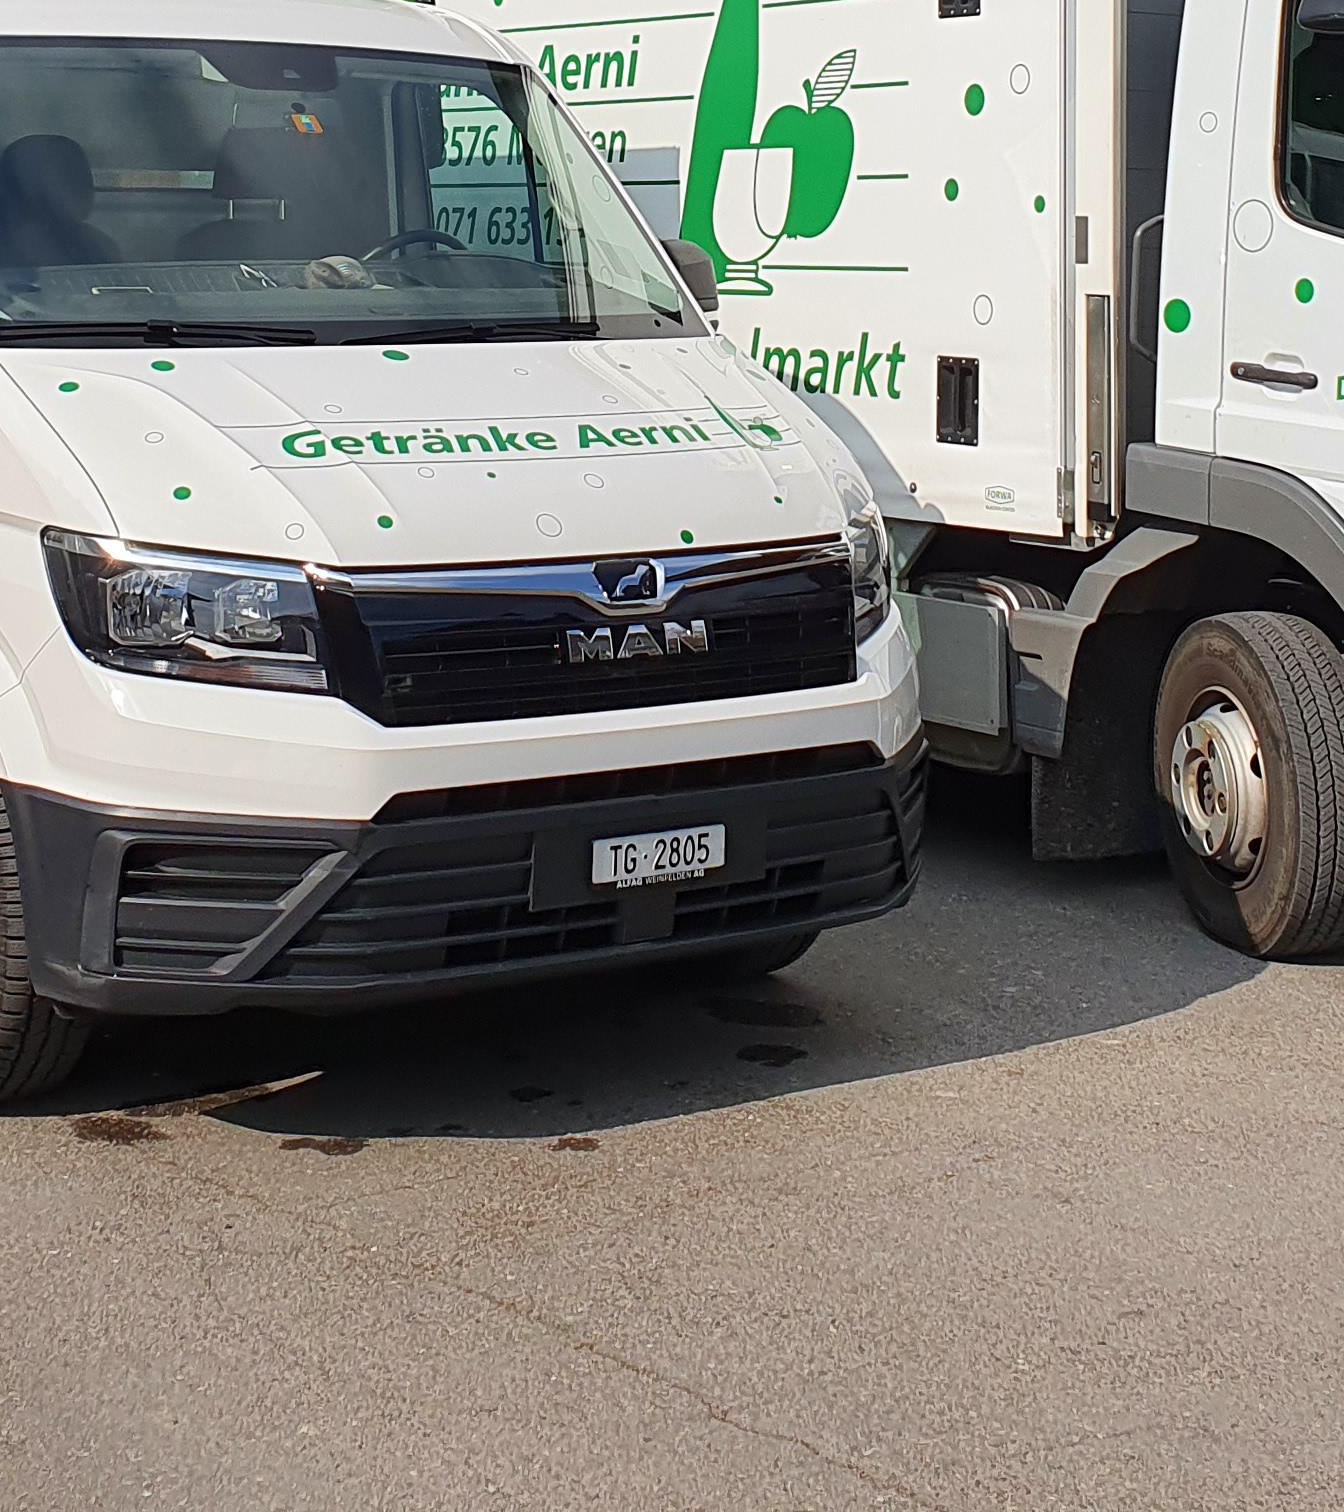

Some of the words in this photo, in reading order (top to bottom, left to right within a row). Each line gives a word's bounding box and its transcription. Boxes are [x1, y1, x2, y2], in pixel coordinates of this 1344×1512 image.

[538, 34, 641, 91] Aerni
[487, 206, 531, 246] 633
[281, 425, 559, 459] Getränke
[577, 416, 713, 450] Aerni
[566, 619, 708, 664] MAN
[693, 868, 705, 878] AG
